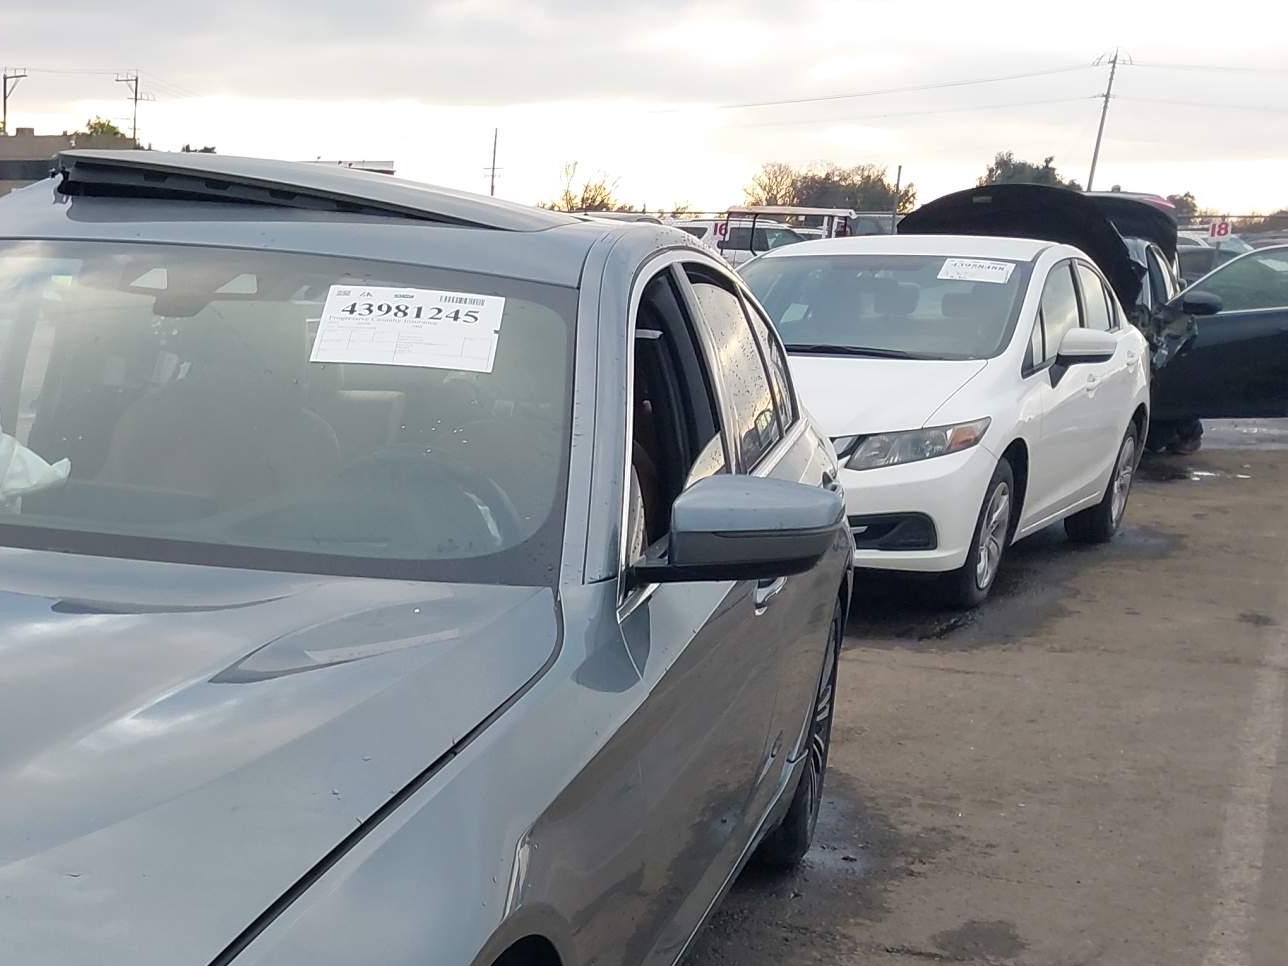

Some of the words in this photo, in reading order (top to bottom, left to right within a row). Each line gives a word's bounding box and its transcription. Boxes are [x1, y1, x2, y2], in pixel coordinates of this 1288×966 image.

[713, 222, 728, 236] 16
[1210, 222, 1229, 237] 18
[341, 302, 481, 325] 43981245
